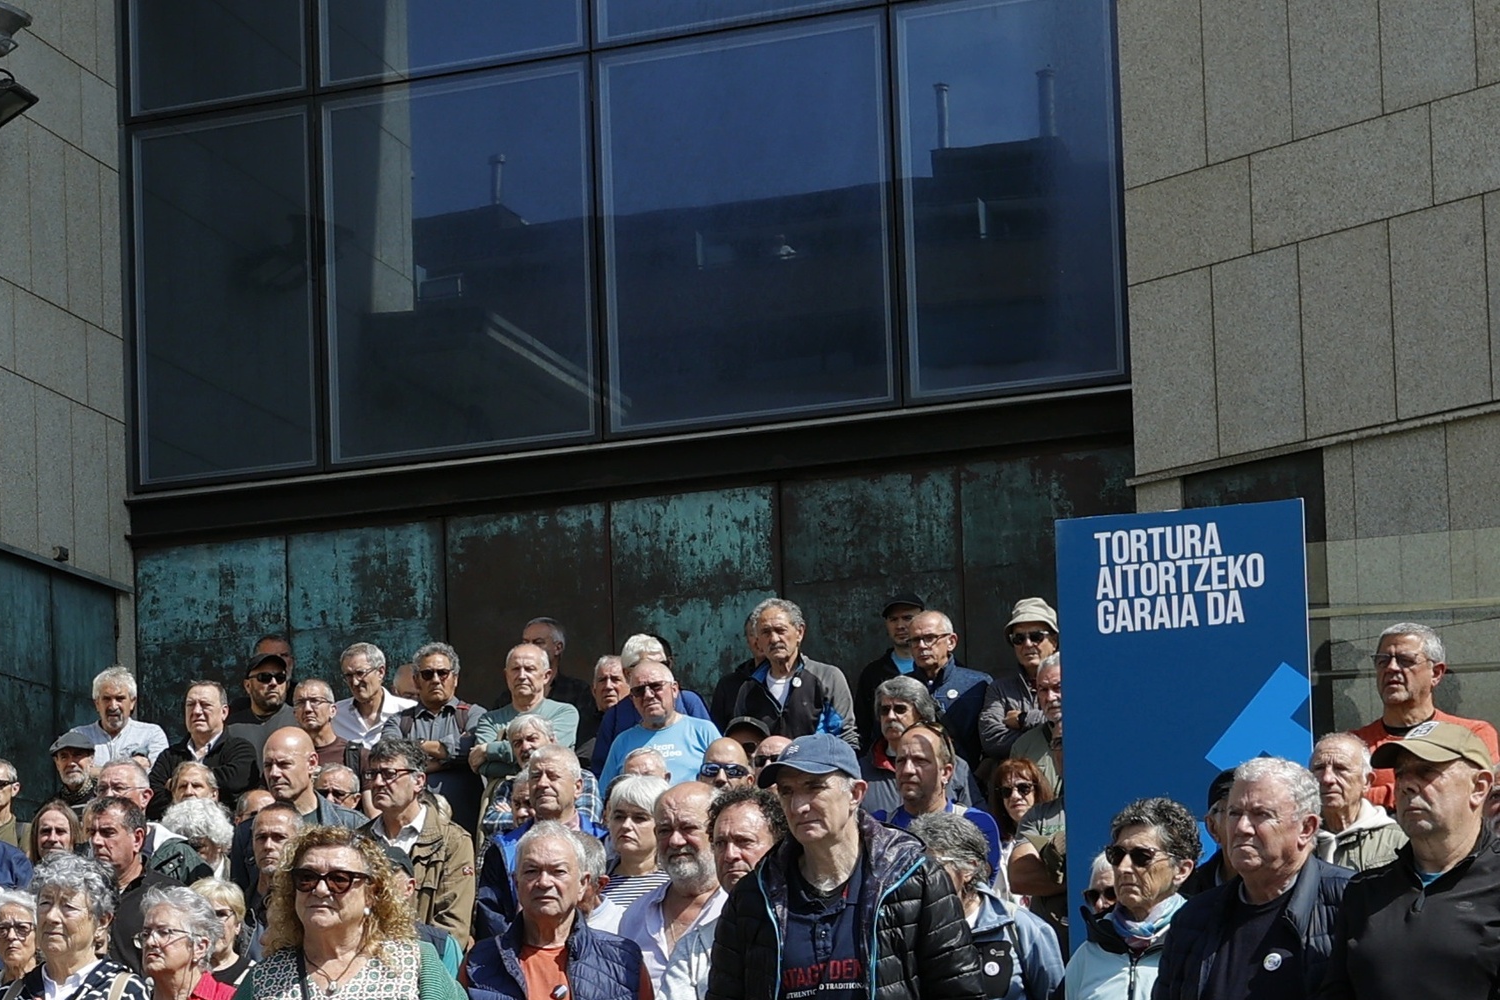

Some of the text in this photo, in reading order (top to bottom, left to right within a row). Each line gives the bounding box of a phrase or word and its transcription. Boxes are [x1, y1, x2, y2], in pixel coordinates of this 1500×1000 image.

[1094, 522, 1222, 565] TORTURA
[1096, 552, 1265, 600] AITORTZEKO
[1096, 589, 1245, 634] GARAIA DA
[829, 958, 862, 980] DEN
